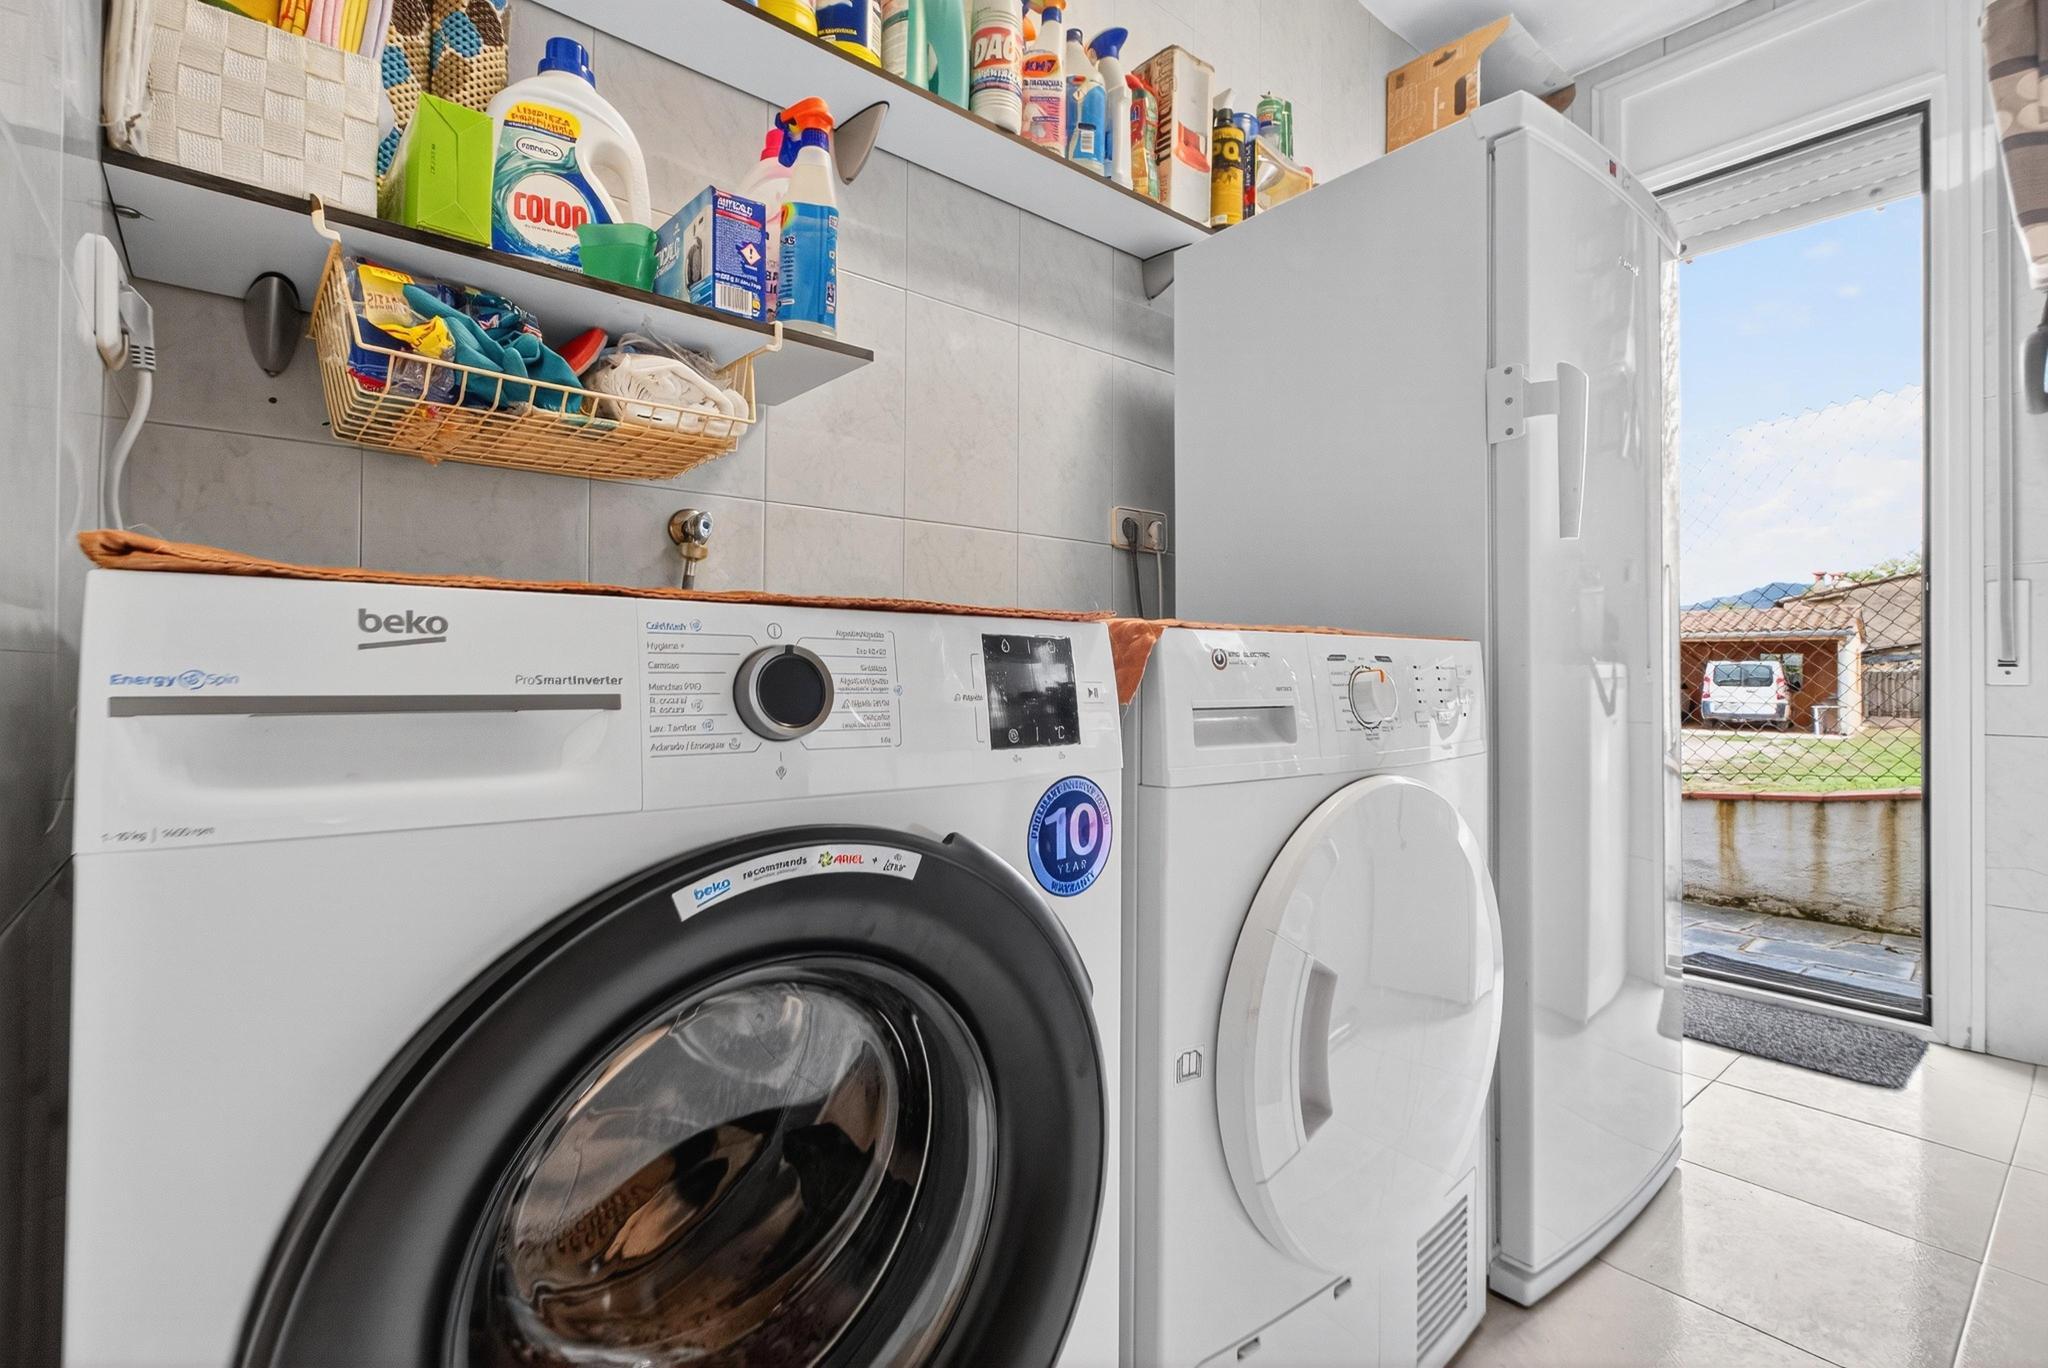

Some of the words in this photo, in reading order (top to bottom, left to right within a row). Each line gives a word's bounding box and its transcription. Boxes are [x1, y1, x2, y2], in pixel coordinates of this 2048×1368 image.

[357, 608, 449, 635] beko
[108, 673, 177, 688] Energy
[206, 673, 241, 687] Spin
[515, 674, 624, 687] ProSmartInverter
[1044, 802, 1098, 861] 10
[693, 878, 731, 901] beko
[742, 856, 807, 880] recommends
[833, 853, 864, 865] ARIEL
[1057, 859, 1088, 875] YEAR
